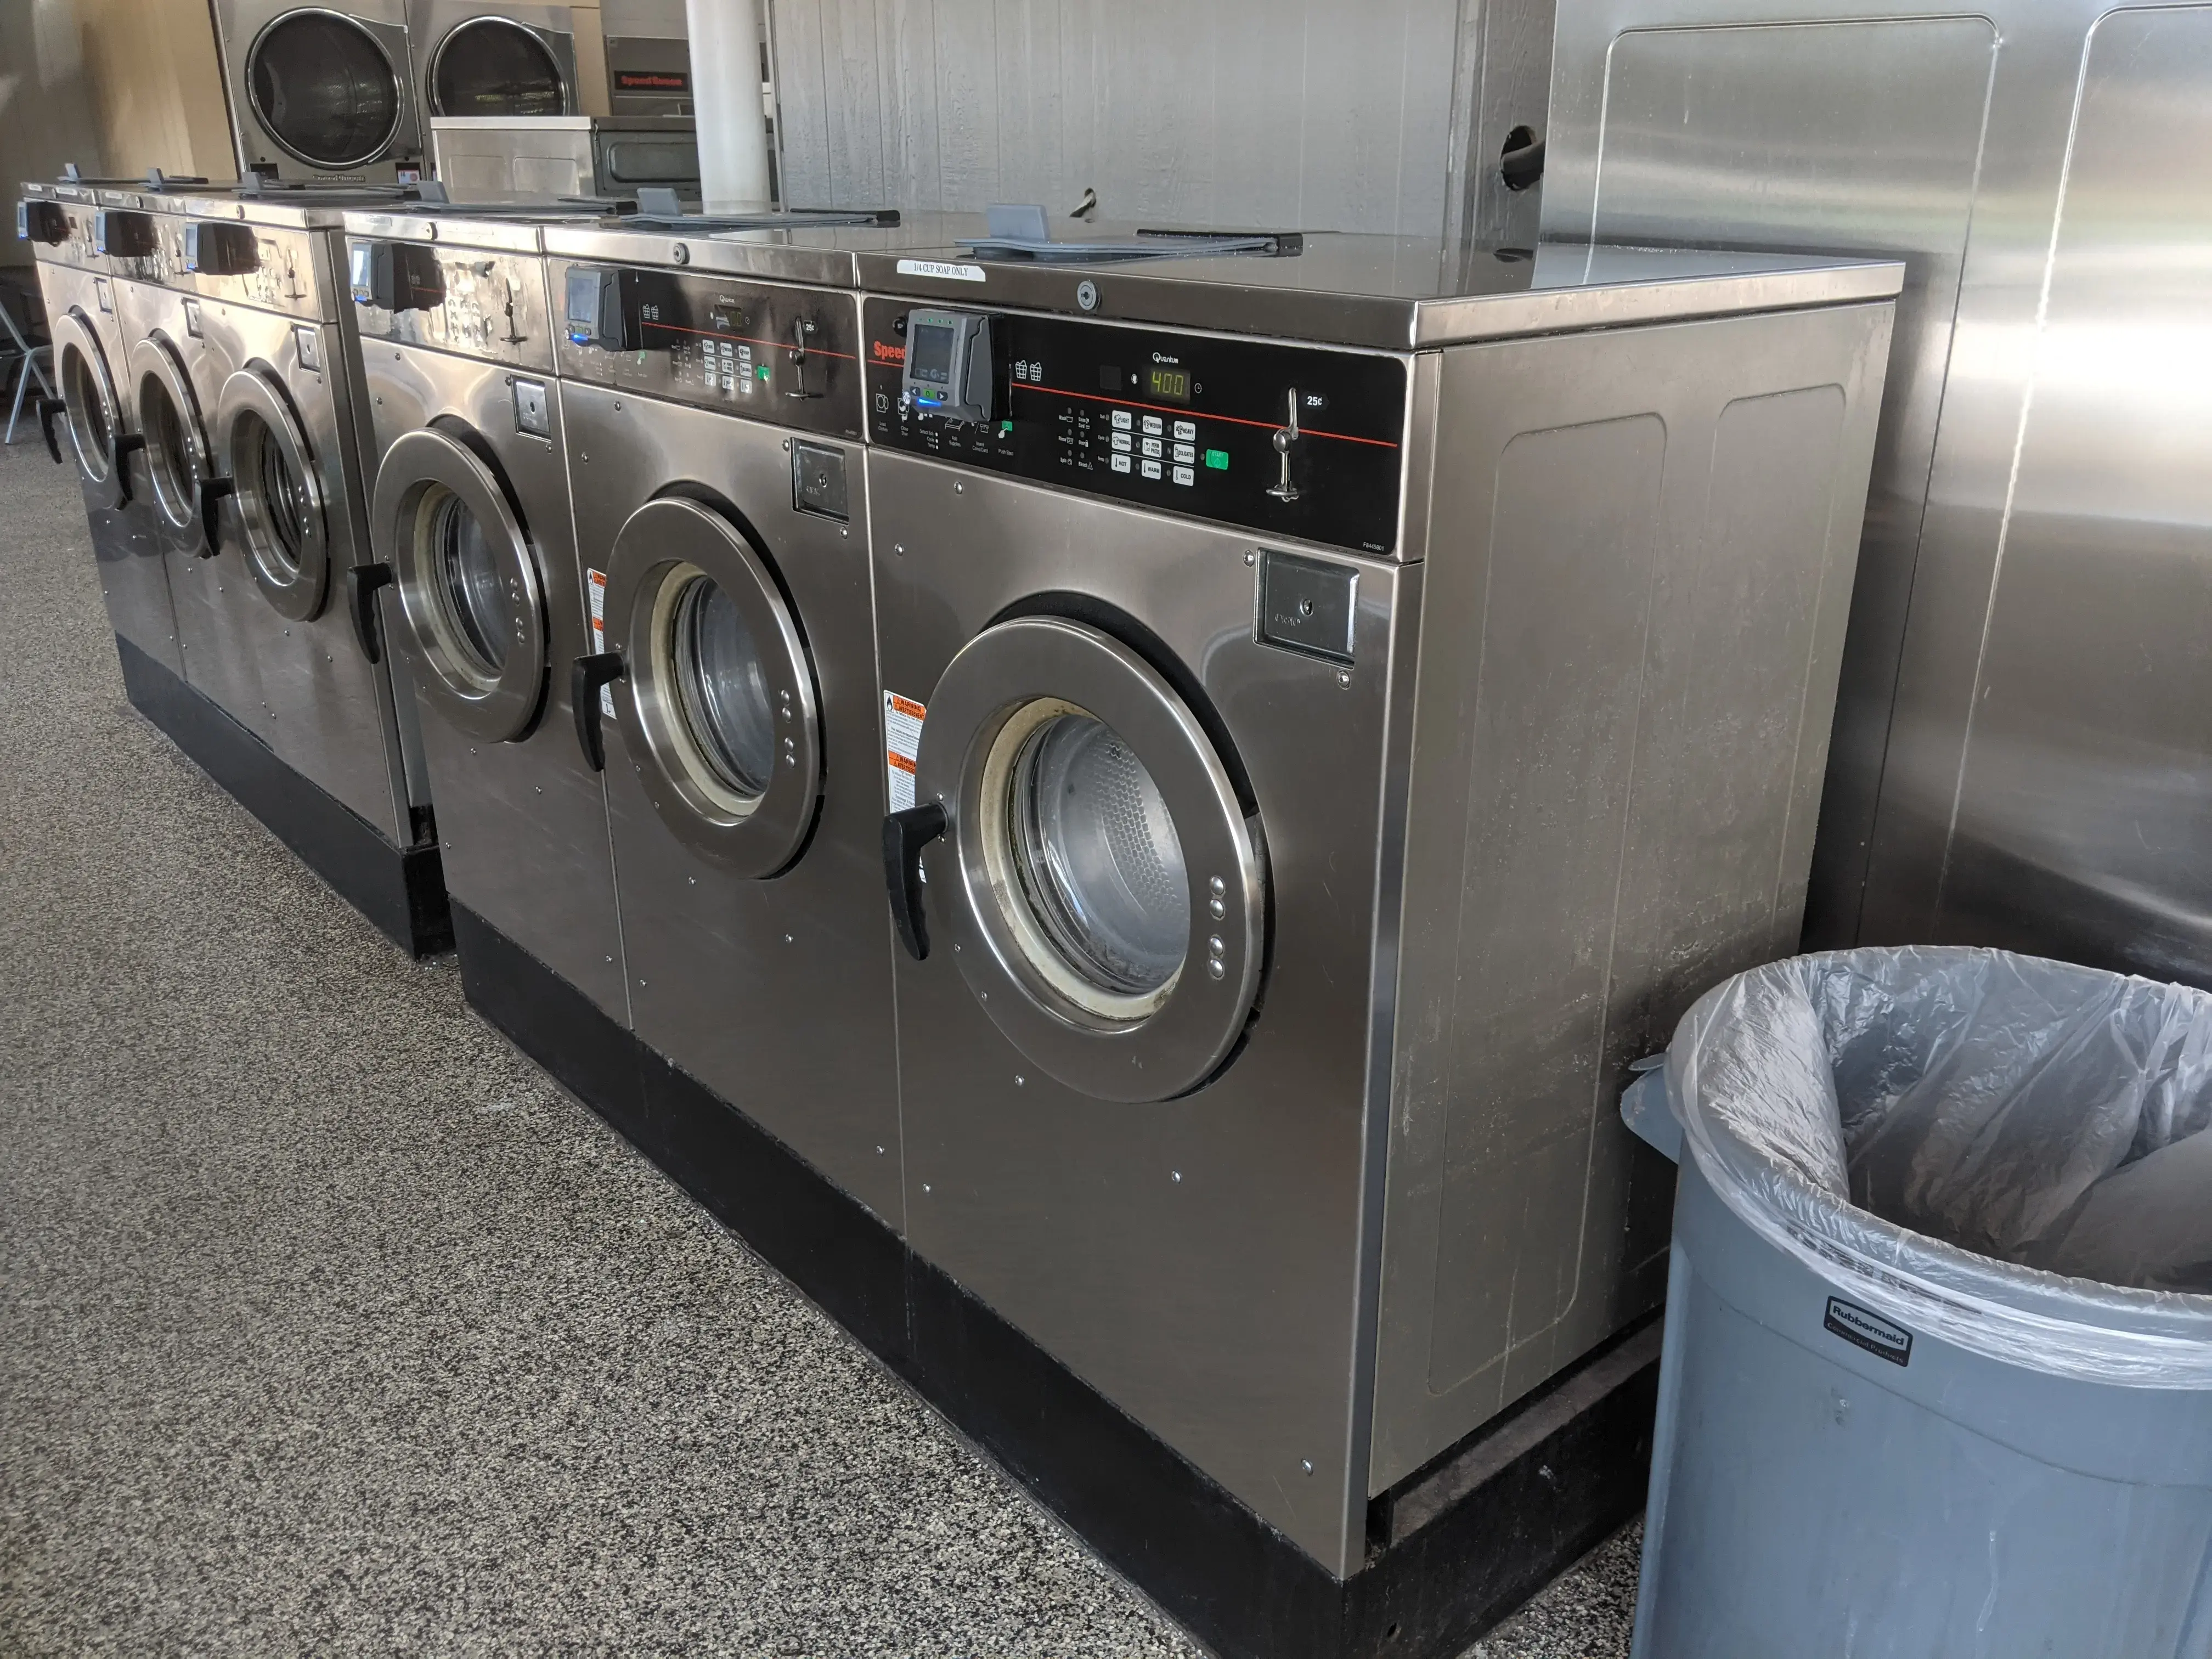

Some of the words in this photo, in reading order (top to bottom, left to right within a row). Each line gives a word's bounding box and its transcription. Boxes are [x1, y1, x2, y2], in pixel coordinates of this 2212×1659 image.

[923, 264, 934, 273] CUP
[935, 265, 950, 274] SOAP
[952, 267, 968, 276] ONLY
[1153, 352, 1178, 363] Quantum
[1153, 371, 1183, 395] 400
[1307, 396, 1323, 406] 25¢
[1833, 1305, 1905, 1346] Rubbermaid
